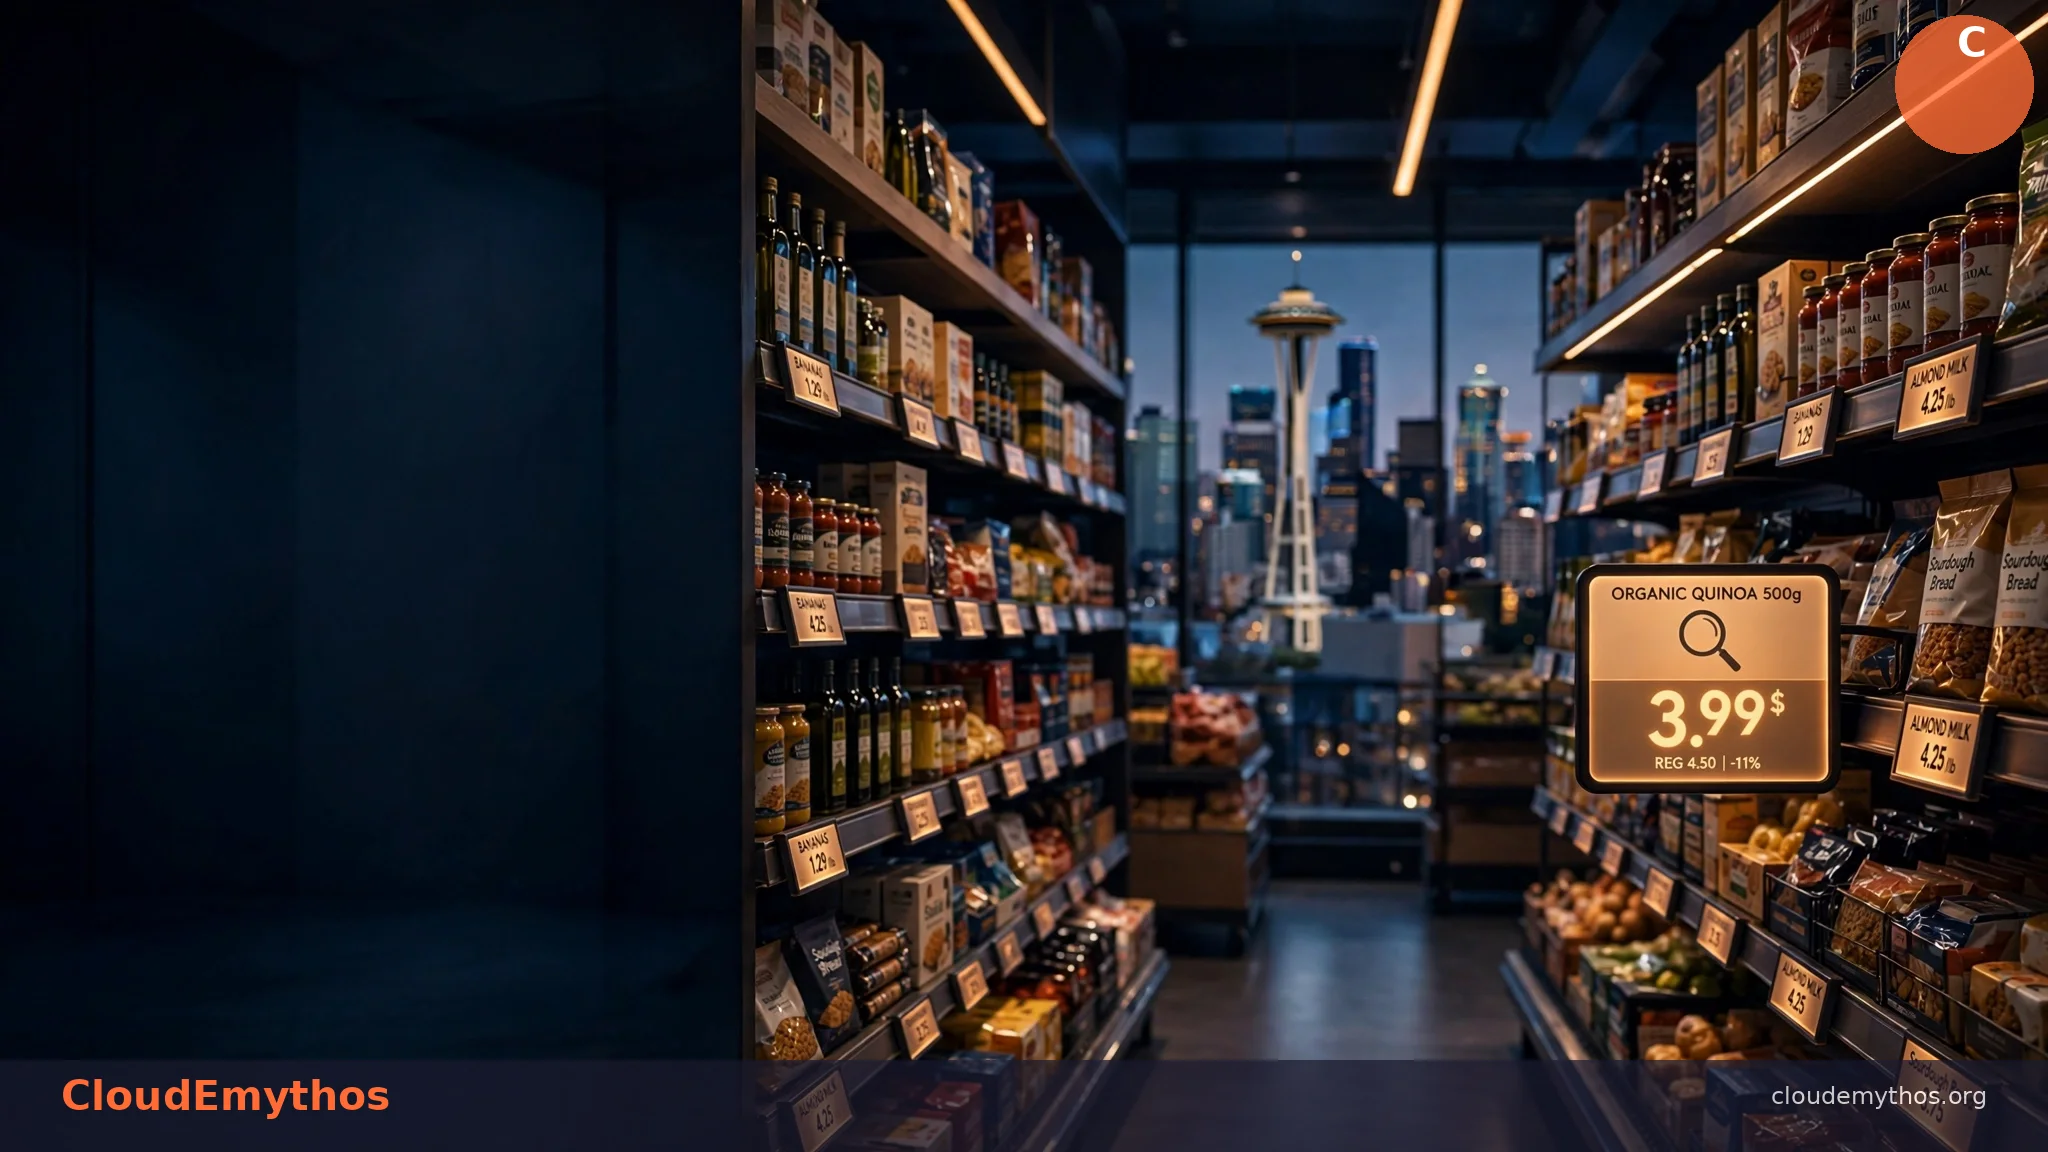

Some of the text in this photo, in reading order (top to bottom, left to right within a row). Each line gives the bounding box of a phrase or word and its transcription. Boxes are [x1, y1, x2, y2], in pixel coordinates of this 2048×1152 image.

[1910, 356, 1969, 389] ALMOND MILK
[1928, 551, 1975, 572] Sourdough
[1929, 574, 1957, 590] Bread
[2006, 572, 2040, 590] Bread
[1611, 586, 1802, 604] ORGANIC QUINOA 500g
[1910, 714, 1972, 742] ALMOND MILK
[1654, 756, 1761, 770] REG 4.50 -11%
[797, 832, 829, 853] BANANAS
[809, 852, 827, 874] 1.29
[1782, 961, 1823, 999] ALMOND MILK
